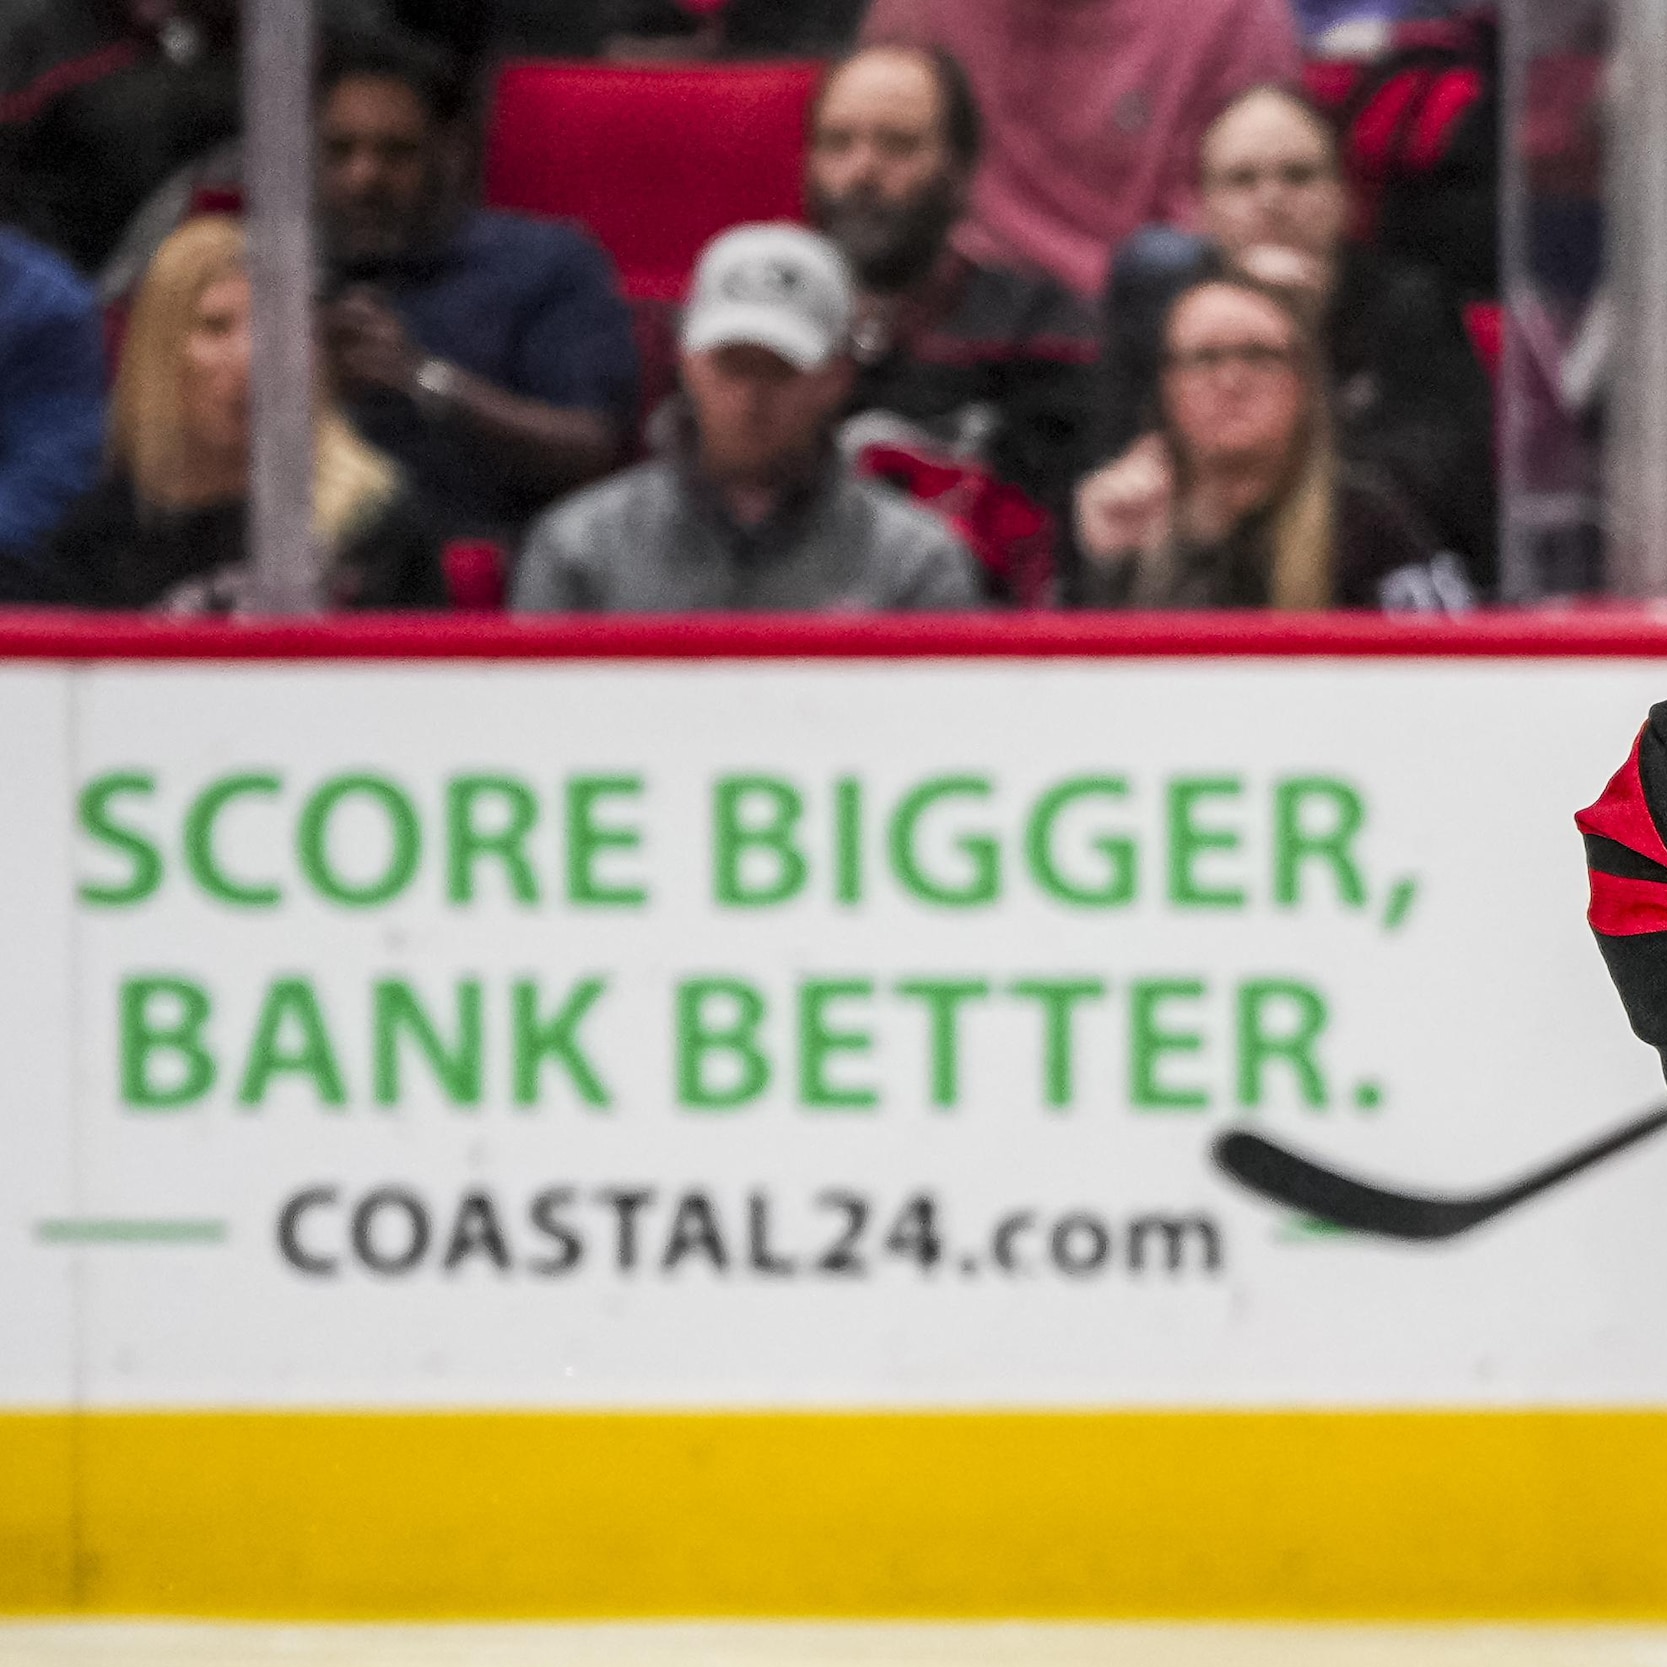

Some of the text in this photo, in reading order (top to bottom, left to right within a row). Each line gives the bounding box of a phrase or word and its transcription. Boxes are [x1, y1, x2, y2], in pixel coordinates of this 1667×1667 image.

[76, 772, 1416, 930] SCORE BIGGER,
[118, 975, 1383, 1110] BANK BETTER.
[276, 1185, 1225, 1278] COASTAL24.com
